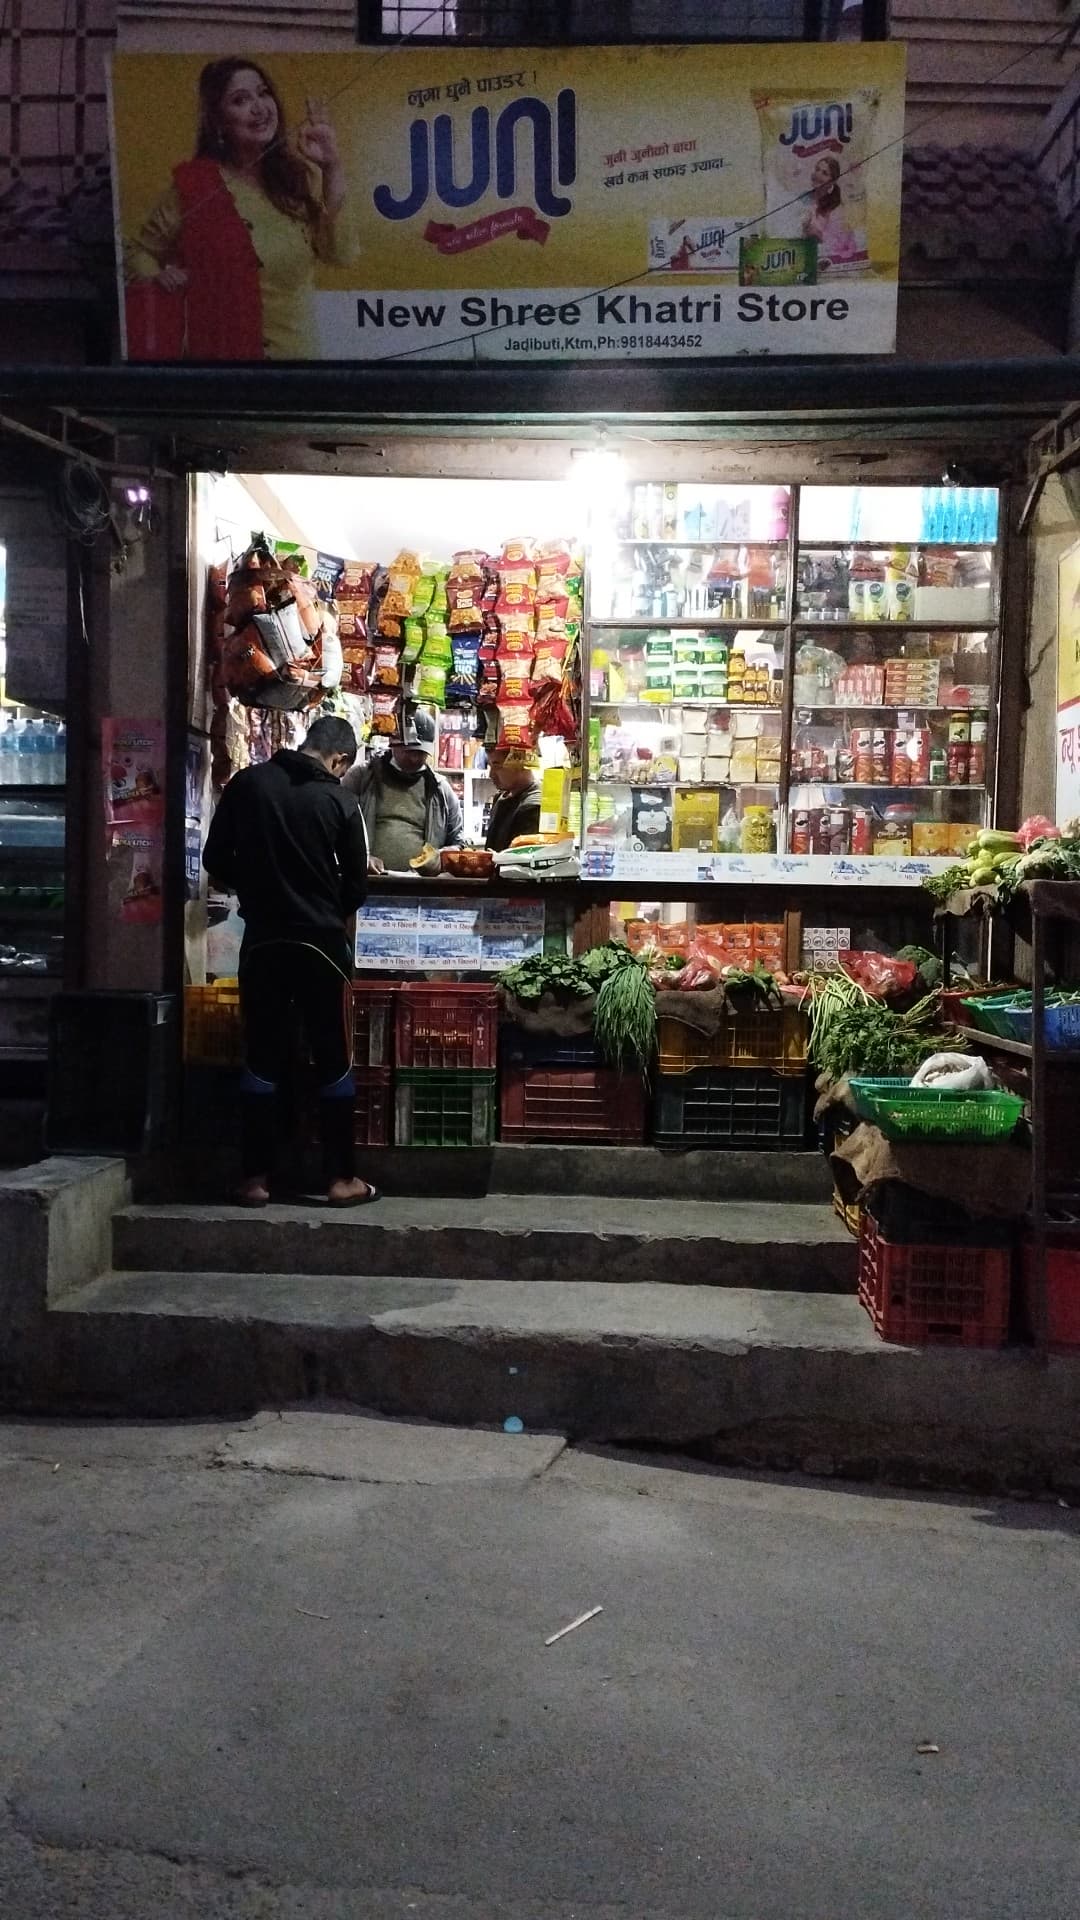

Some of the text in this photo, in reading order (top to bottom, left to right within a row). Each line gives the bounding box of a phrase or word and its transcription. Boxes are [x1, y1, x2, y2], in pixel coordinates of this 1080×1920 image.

[476, 70, 527, 93] पाउडर
[778, 102, 853, 146] JUNI
[373, 87, 577, 221] JUNI
[761, 248, 796, 271] JUNI
[357, 292, 849, 328] New Shree Khatri Store
